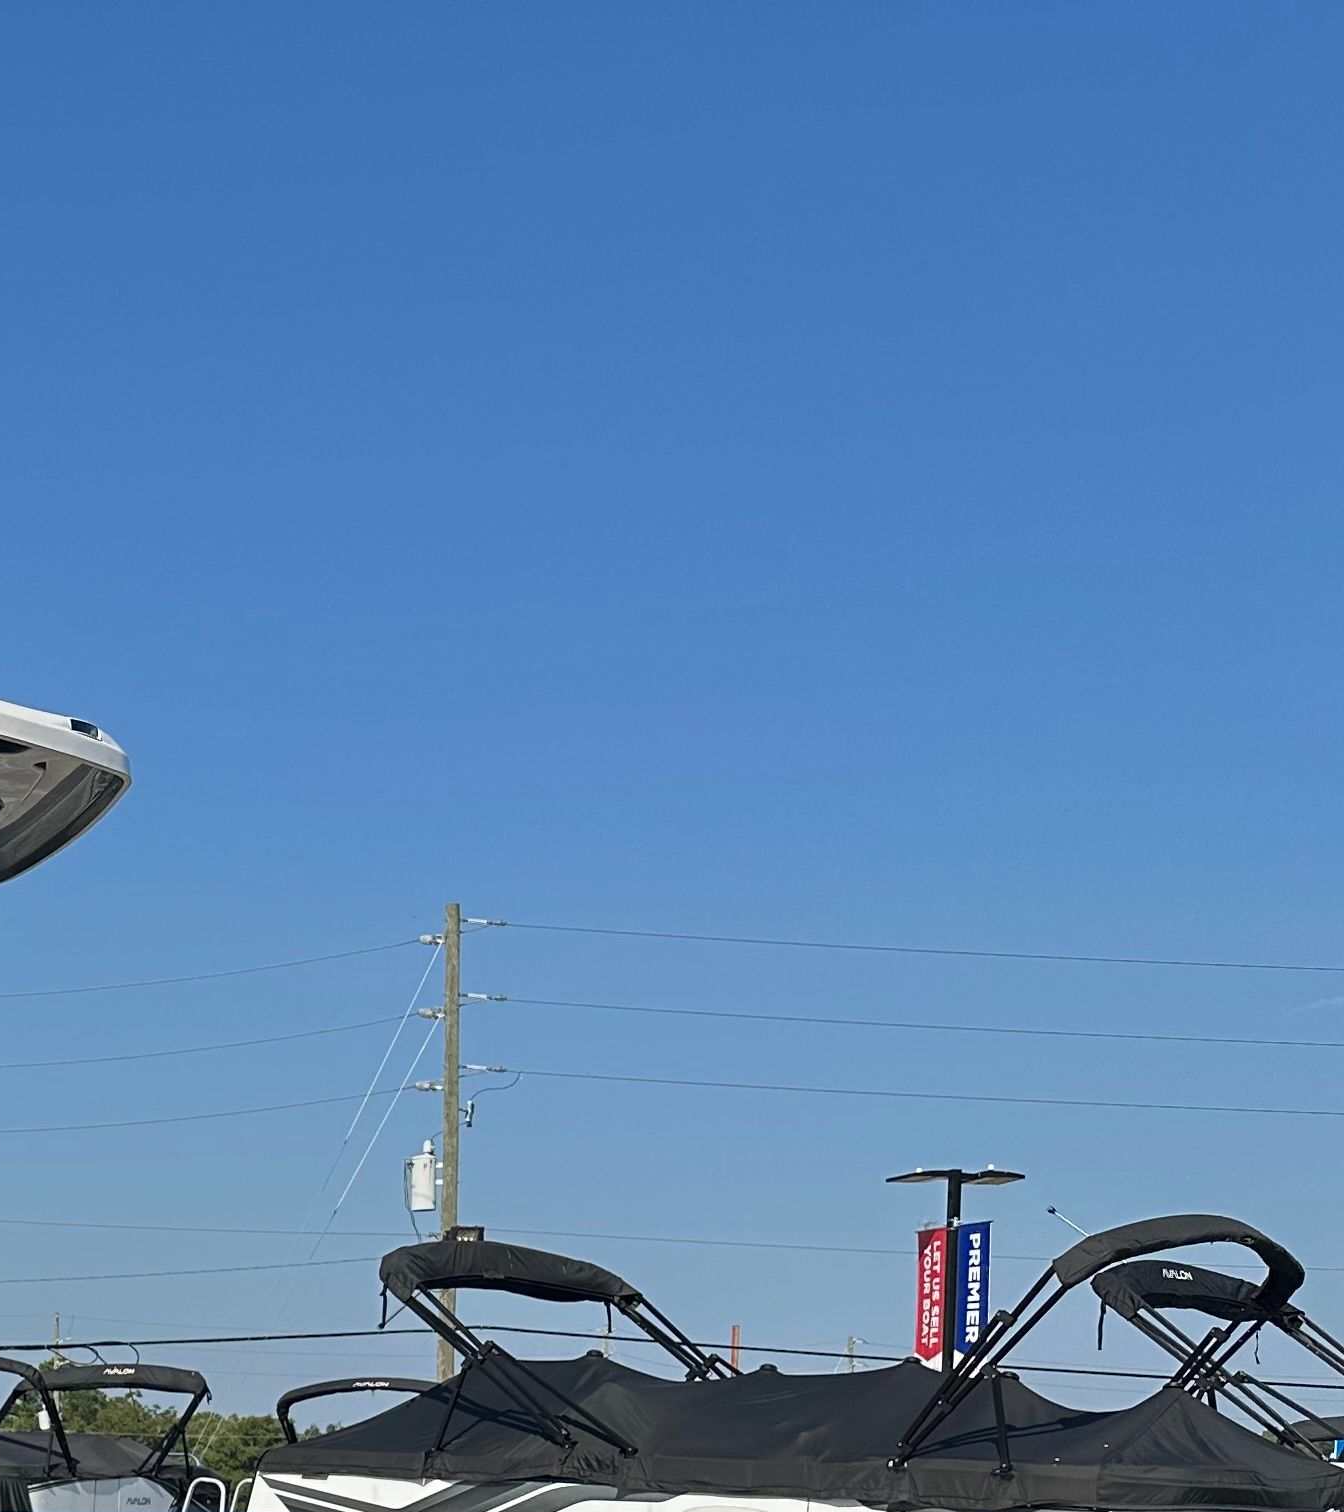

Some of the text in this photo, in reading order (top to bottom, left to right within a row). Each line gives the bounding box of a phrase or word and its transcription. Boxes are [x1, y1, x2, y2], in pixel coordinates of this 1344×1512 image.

[921, 1245, 931, 1346] YOUR BOAT
[928, 1241, 941, 1348] LET US SELL
[965, 1232, 981, 1343] PREMIER
[1162, 1268, 1193, 1281] AVALON
